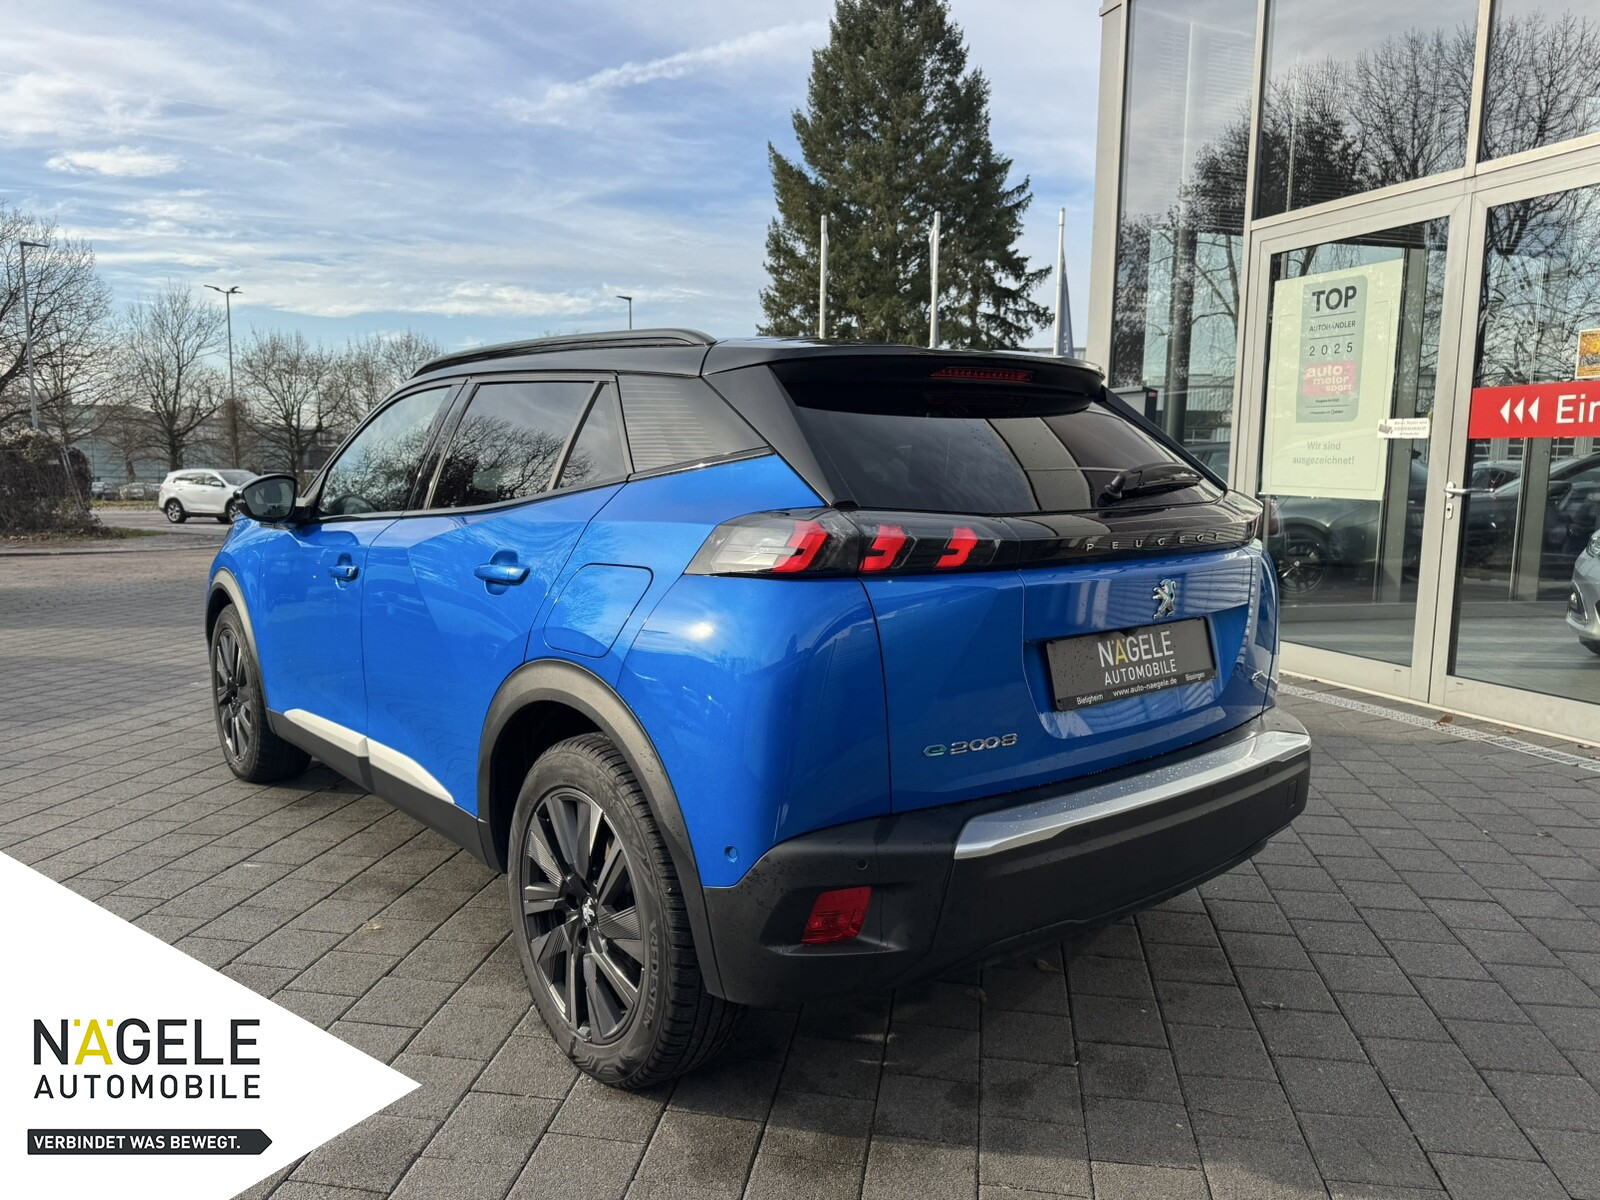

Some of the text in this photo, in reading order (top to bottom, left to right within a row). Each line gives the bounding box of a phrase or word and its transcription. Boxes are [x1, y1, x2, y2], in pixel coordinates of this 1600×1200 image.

[1312, 286, 1357, 312] TOP
[1306, 365, 1343, 378] auto
[1313, 375, 1349, 385] motor
[1325, 383, 1352, 393] sport
[1307, 441, 1341, 451] Wir sind
[1293, 455, 1355, 466] ausgezeichnet!
[1086, 532, 1221, 552] PEUGEOT
[1097, 631, 1174, 668] NÄGELE
[1104, 659, 1178, 686] AUTOMOBILE
[1112, 677, 1178, 697] www.auto-naegele.de
